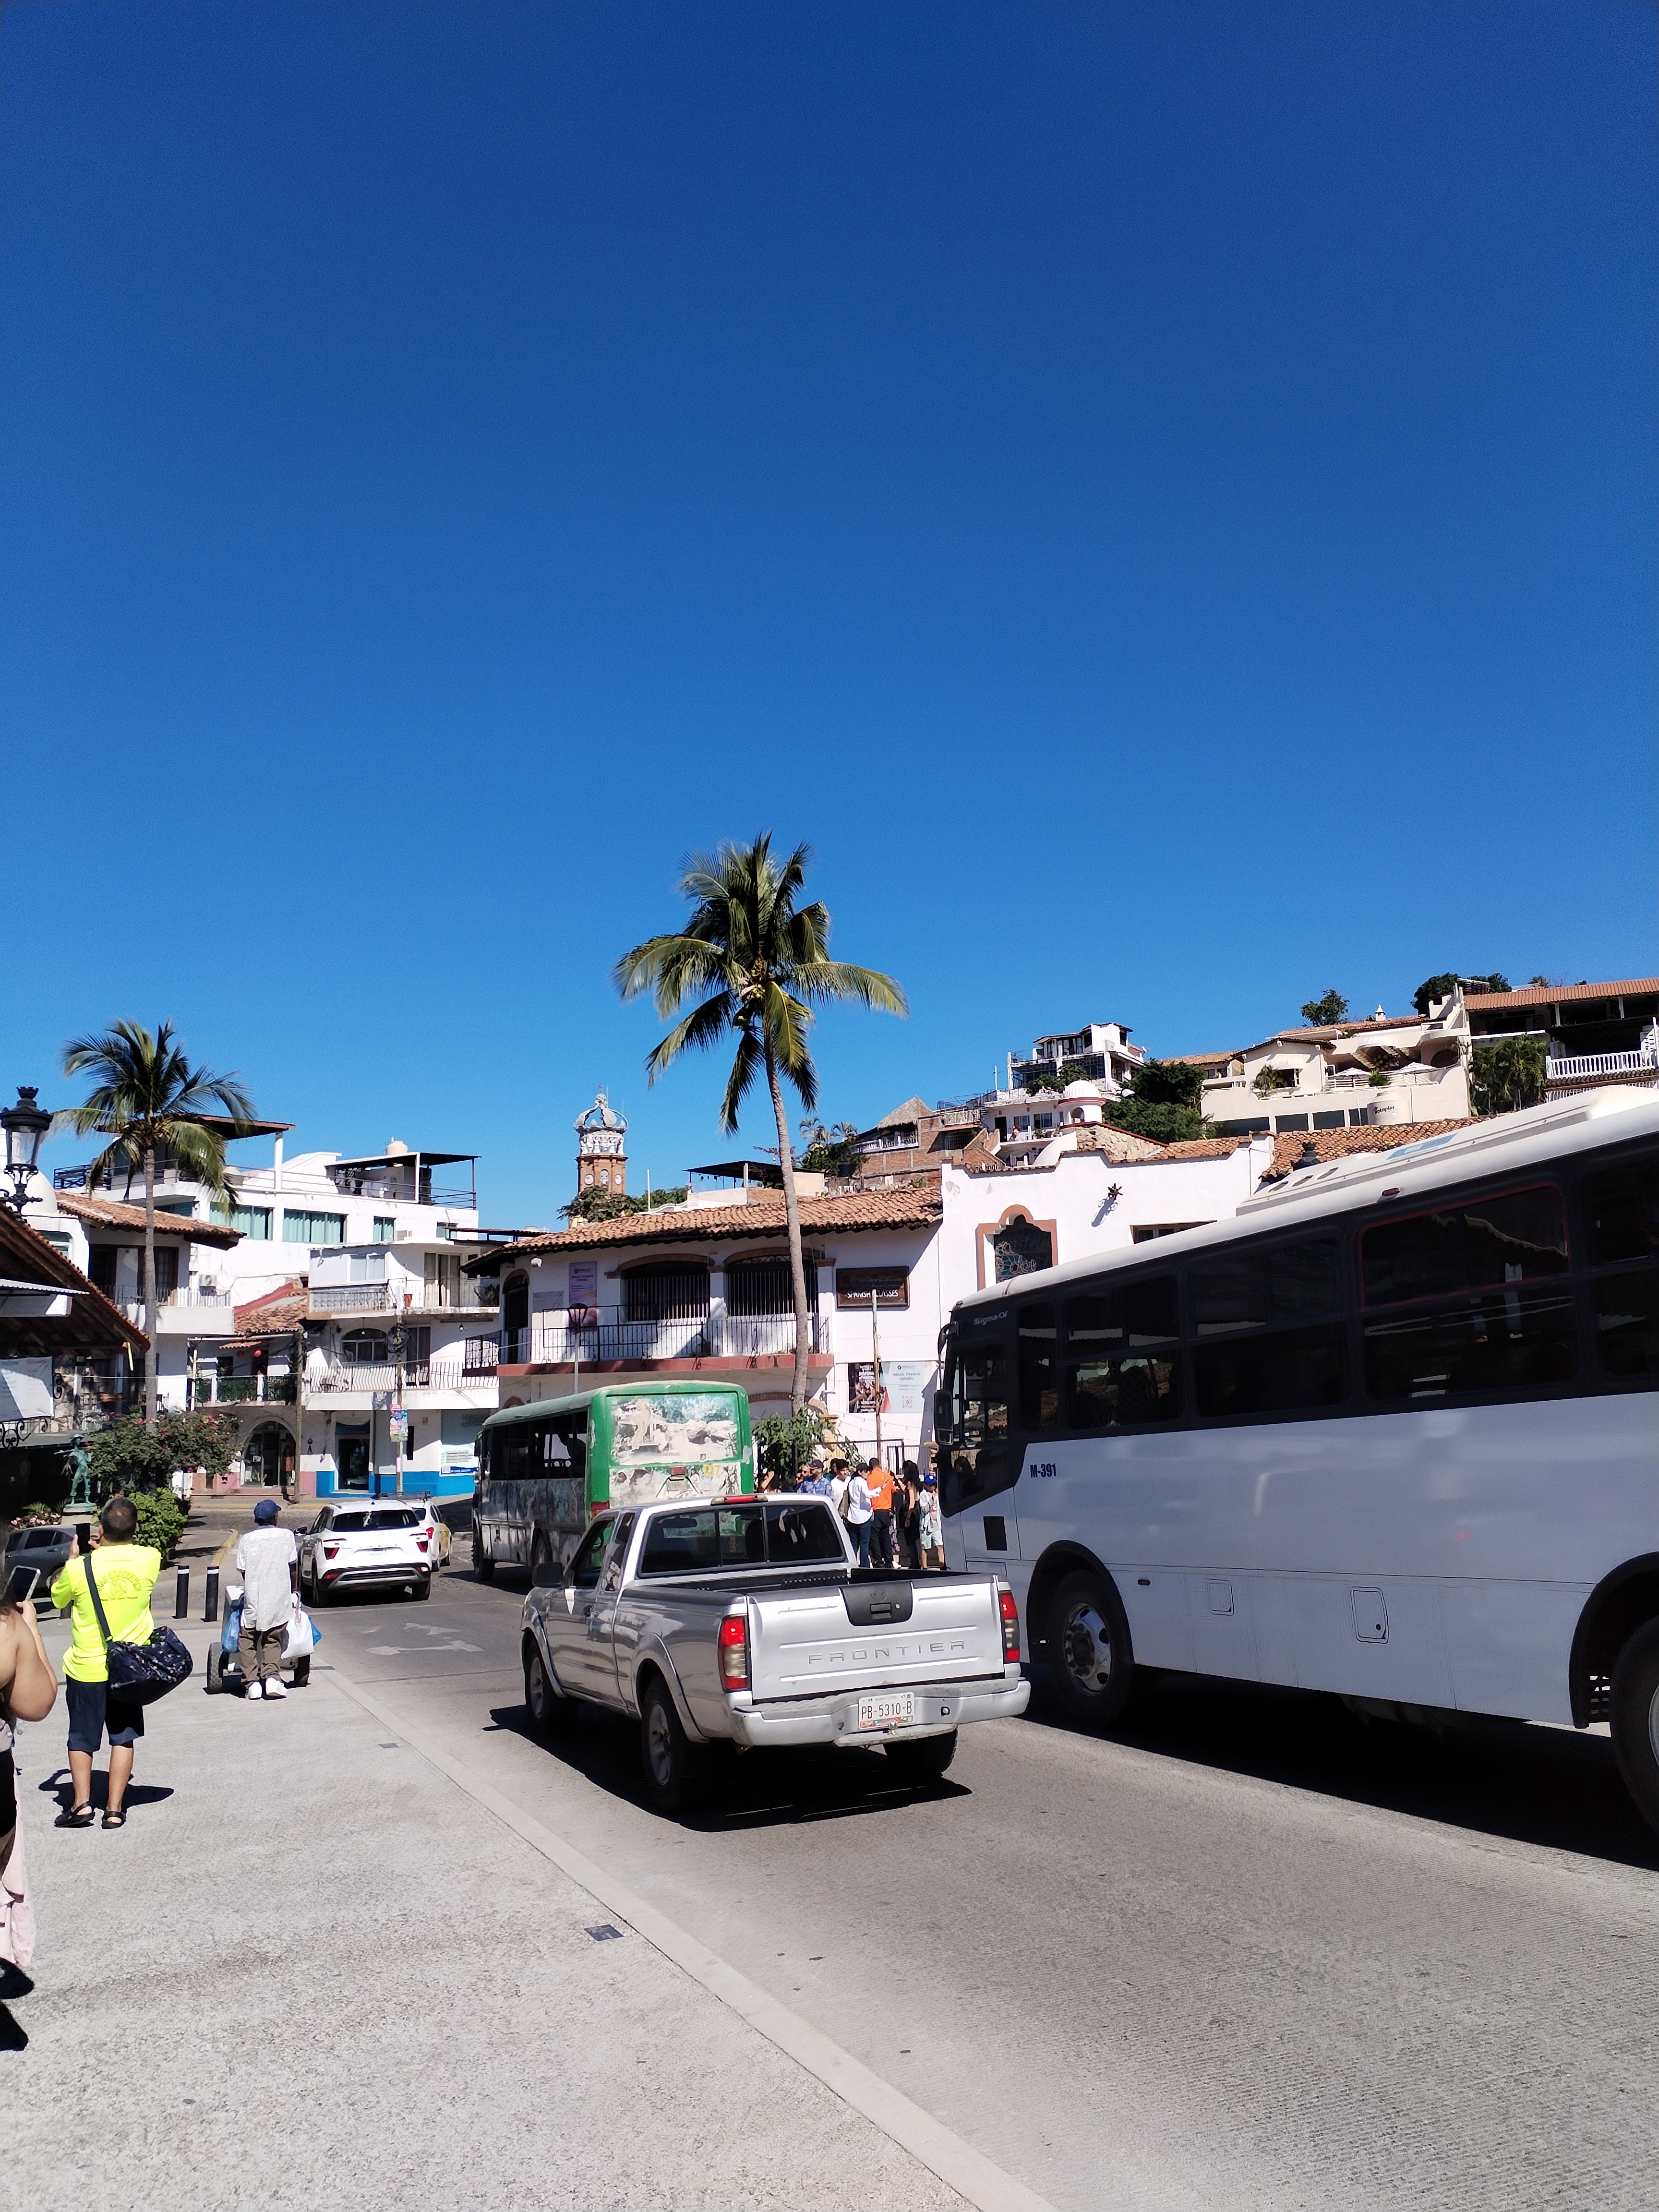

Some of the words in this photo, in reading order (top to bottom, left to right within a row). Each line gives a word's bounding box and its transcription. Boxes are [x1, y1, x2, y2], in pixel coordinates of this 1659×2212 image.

[847, 1290, 871, 1298] SPANISH
[702, 1465, 721, 1477] 127
[1030, 1463, 1057, 1478] M-391
[808, 1640, 965, 1664] FRONTIER
[862, 1701, 912, 1720] PB-5310-B
